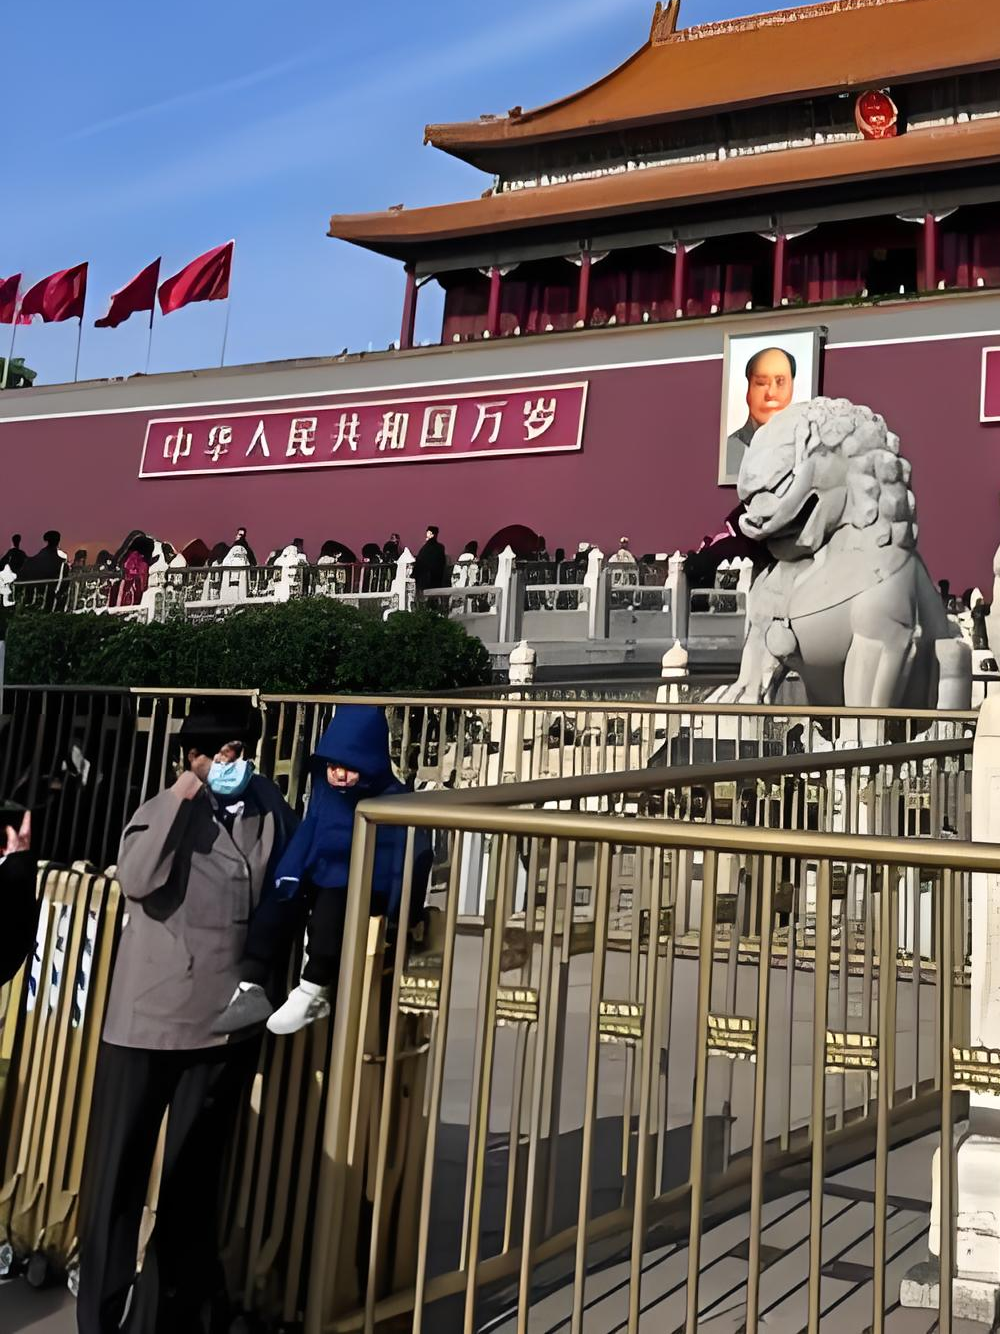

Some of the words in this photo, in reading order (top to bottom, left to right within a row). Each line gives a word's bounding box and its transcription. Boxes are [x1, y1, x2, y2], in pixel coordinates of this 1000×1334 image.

[162, 397, 558, 464] 中华人民共和国万岁
